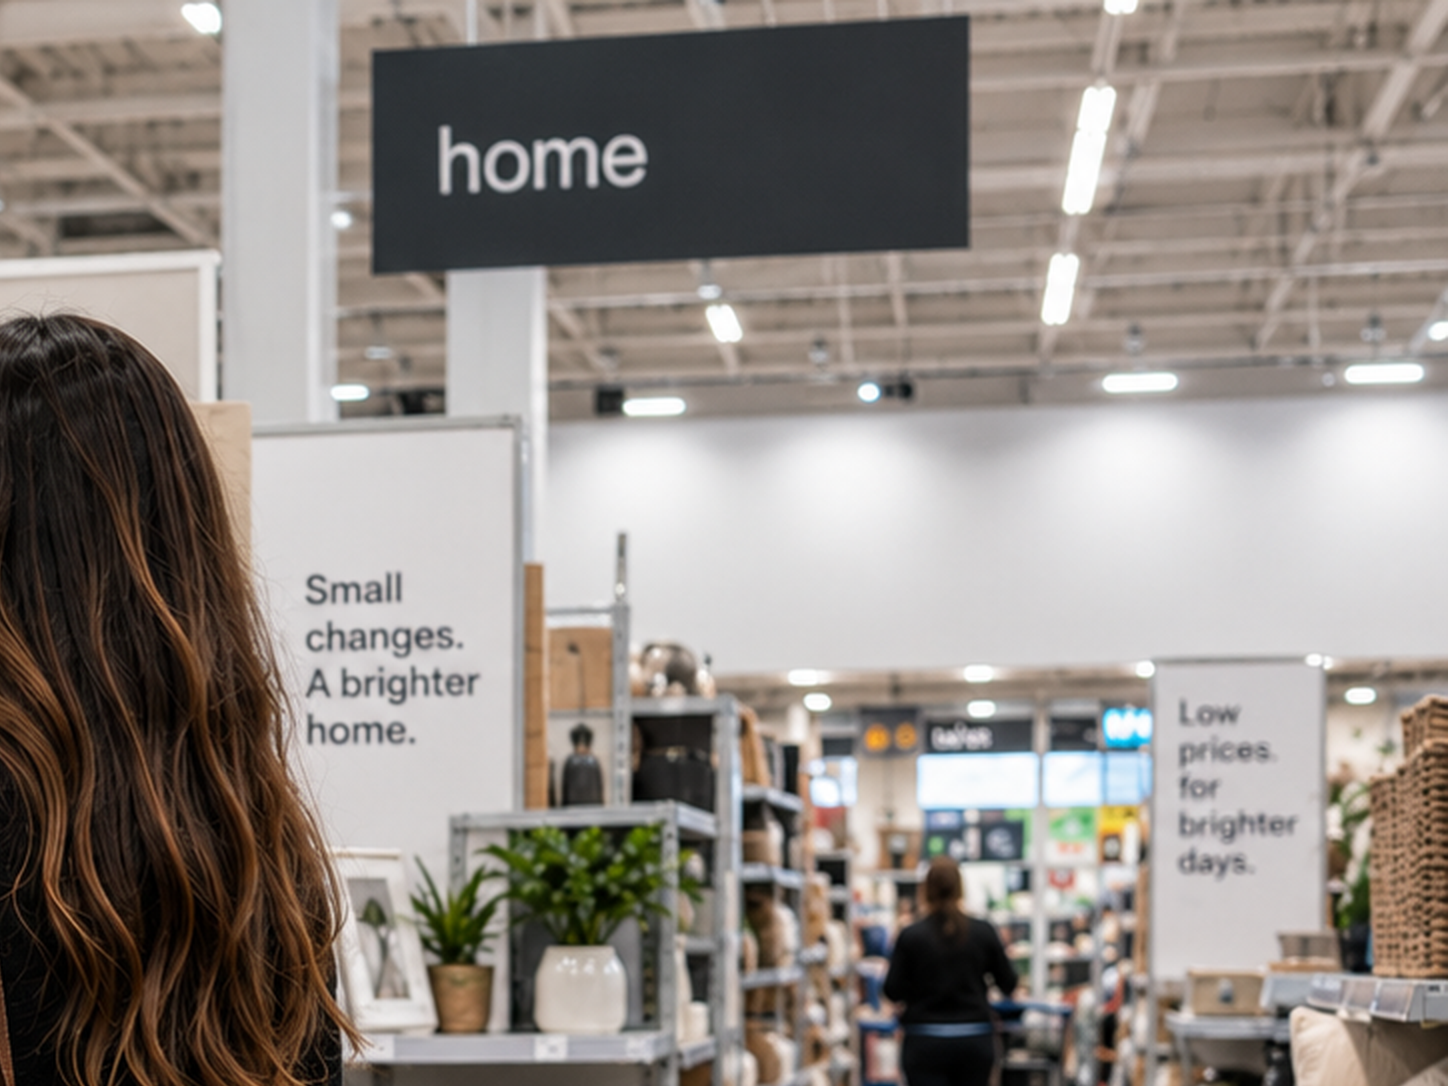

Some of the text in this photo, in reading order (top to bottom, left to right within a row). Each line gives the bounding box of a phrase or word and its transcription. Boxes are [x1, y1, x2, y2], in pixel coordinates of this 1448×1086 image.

[438, 125, 648, 195] home
[305, 571, 402, 605] Small
[305, 620, 463, 659] changes.
[305, 665, 480, 706] A brighter
[306, 713, 416, 745] home.
[1178, 698, 1241, 727] Low
[1178, 773, 1220, 800] for
[1178, 810, 1298, 845] brighter
[1177, 847, 1255, 881] days.
